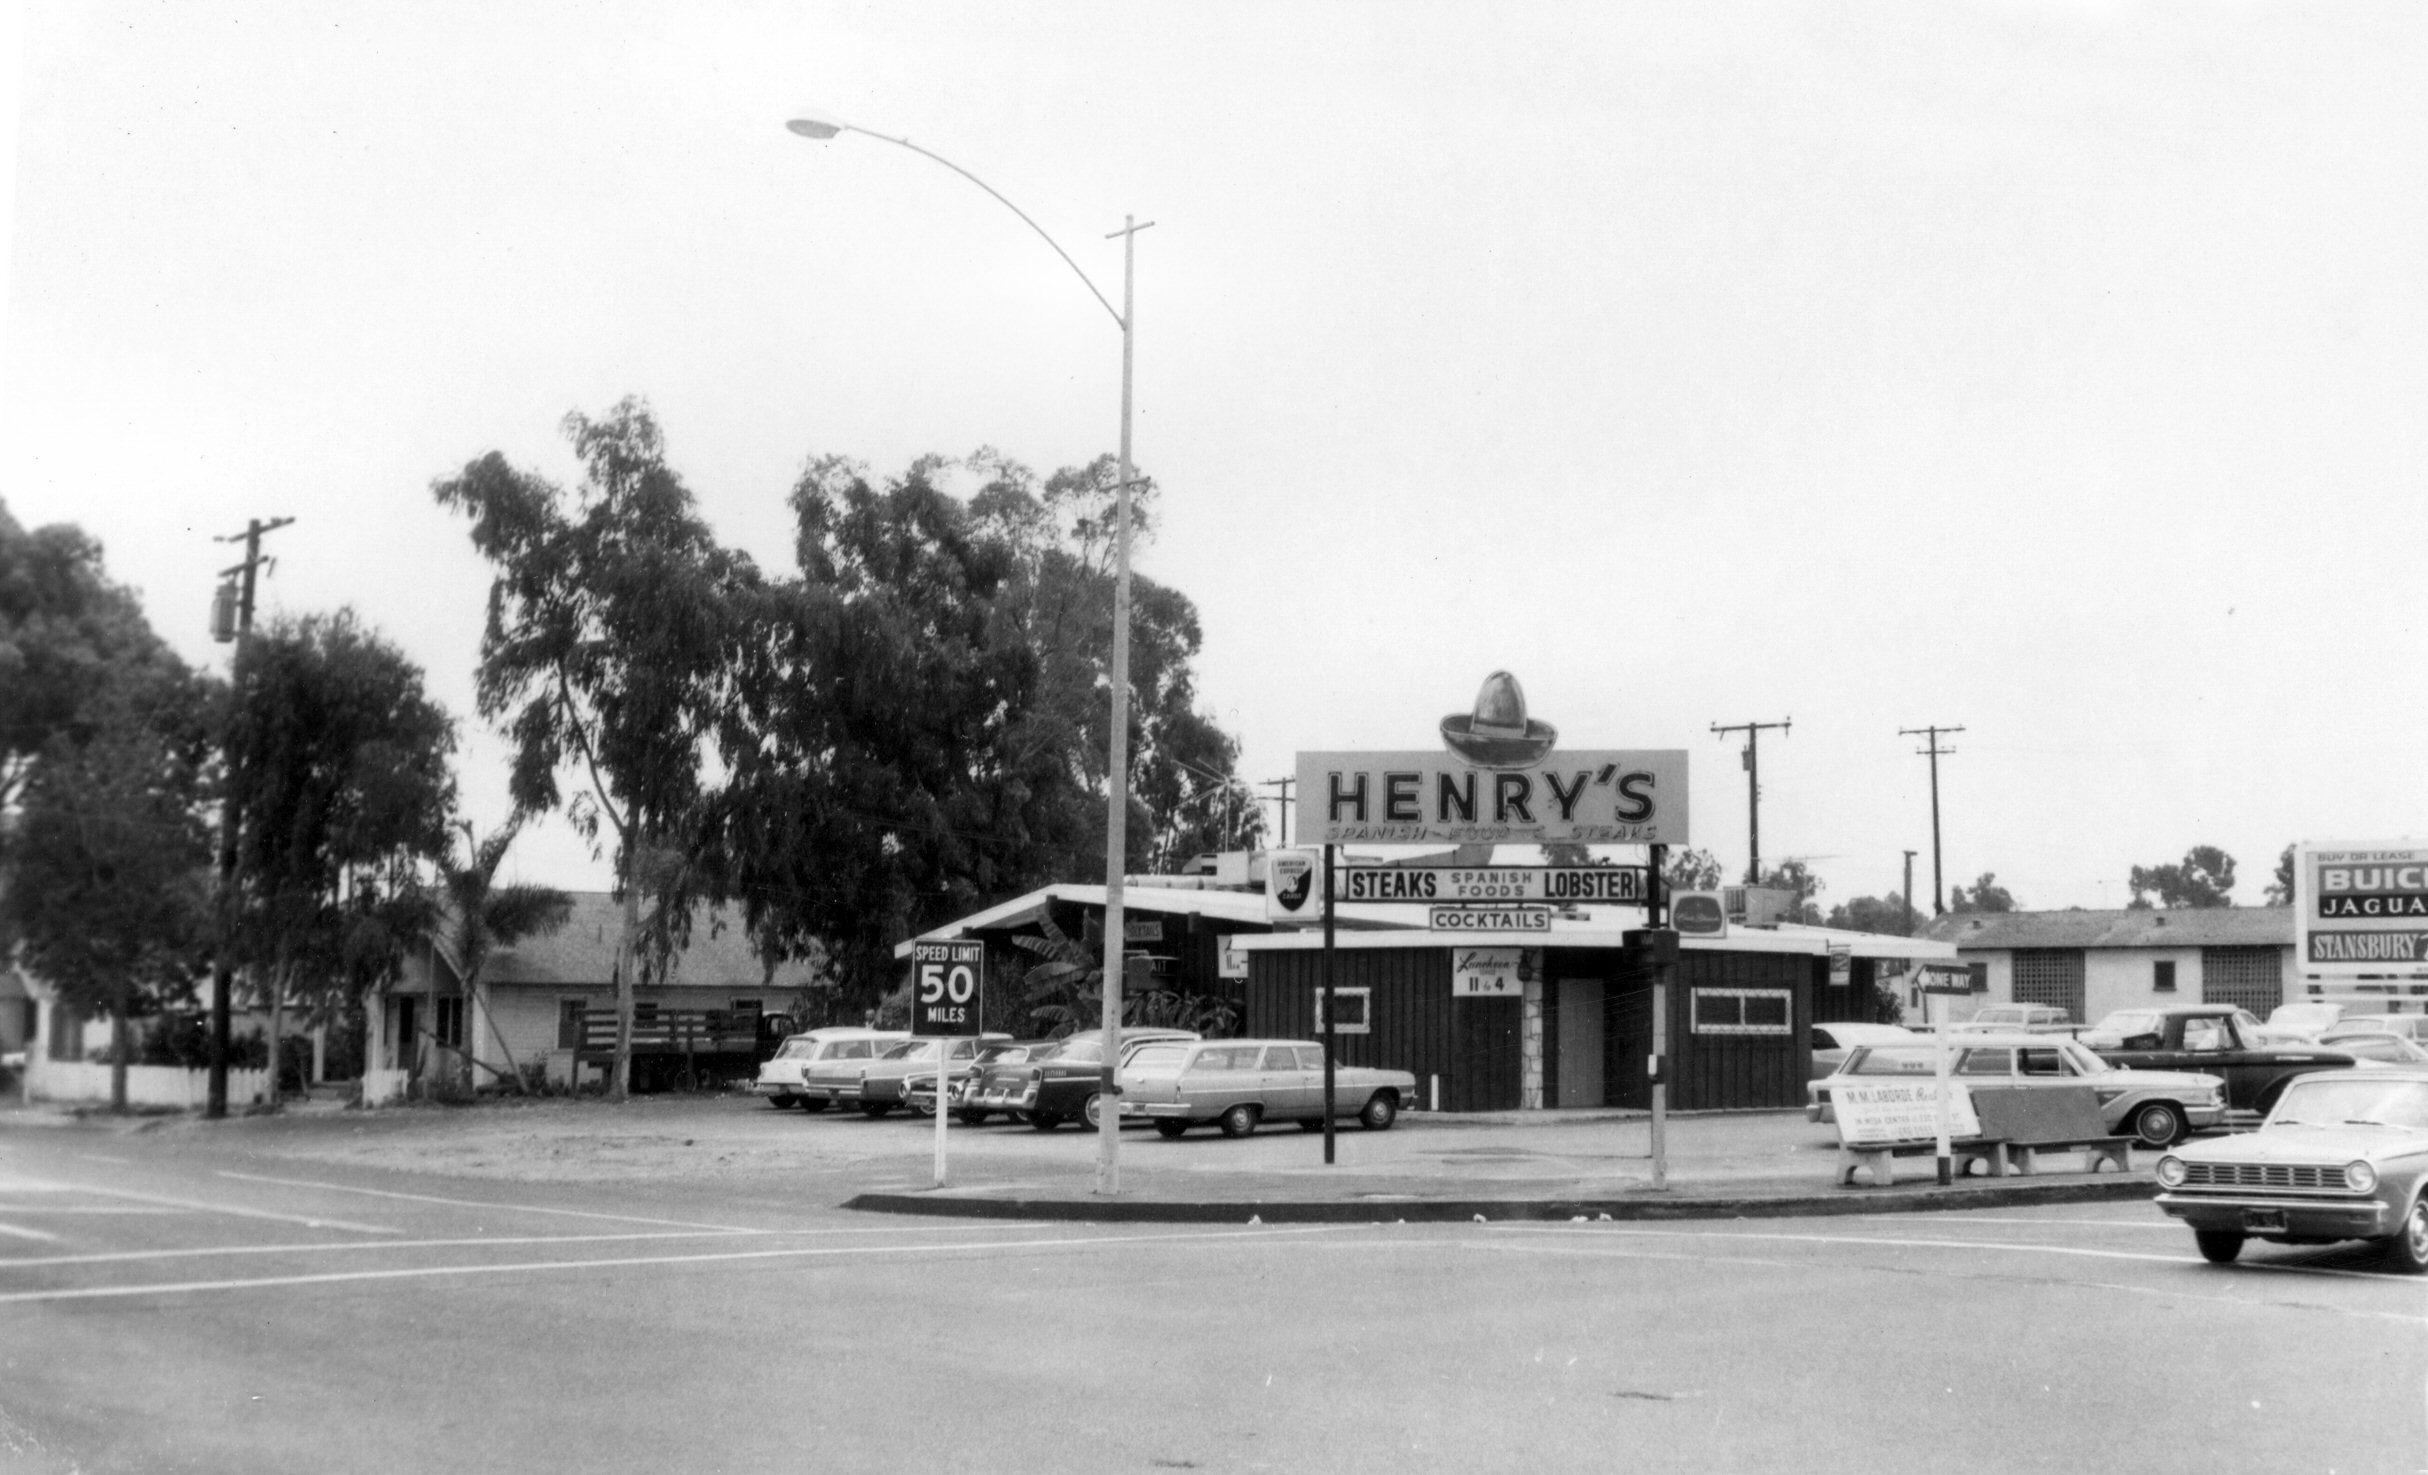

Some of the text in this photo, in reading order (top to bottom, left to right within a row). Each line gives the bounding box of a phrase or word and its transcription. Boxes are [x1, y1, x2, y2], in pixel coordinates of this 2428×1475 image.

[1327, 763, 1656, 824] HENRY'S
[1324, 825, 1428, 841] SPANISH
[1571, 825, 1658, 841] STEAKS
[2317, 852, 2413, 861] BUY OR LEASE
[1352, 872, 1437, 898] STEAKS
[1451, 872, 1532, 884] SPANISH
[1544, 872, 1634, 898] LOBSTER
[1458, 885, 1525, 897] FOODS
[1436, 913, 1546, 929] COCKTAILS
[916, 945, 980, 961] SPEED LIMIT
[2314, 934, 2419, 959] STANSBURY
[1151, 960, 1167, 972] AIT
[920, 965, 974, 1004] 50
[1495, 976, 1505, 992] 4
[1929, 972, 1971, 988] ONE WAY
[927, 1007, 965, 1022] MILES
[1871, 1088, 1913, 1103] LABORDE
